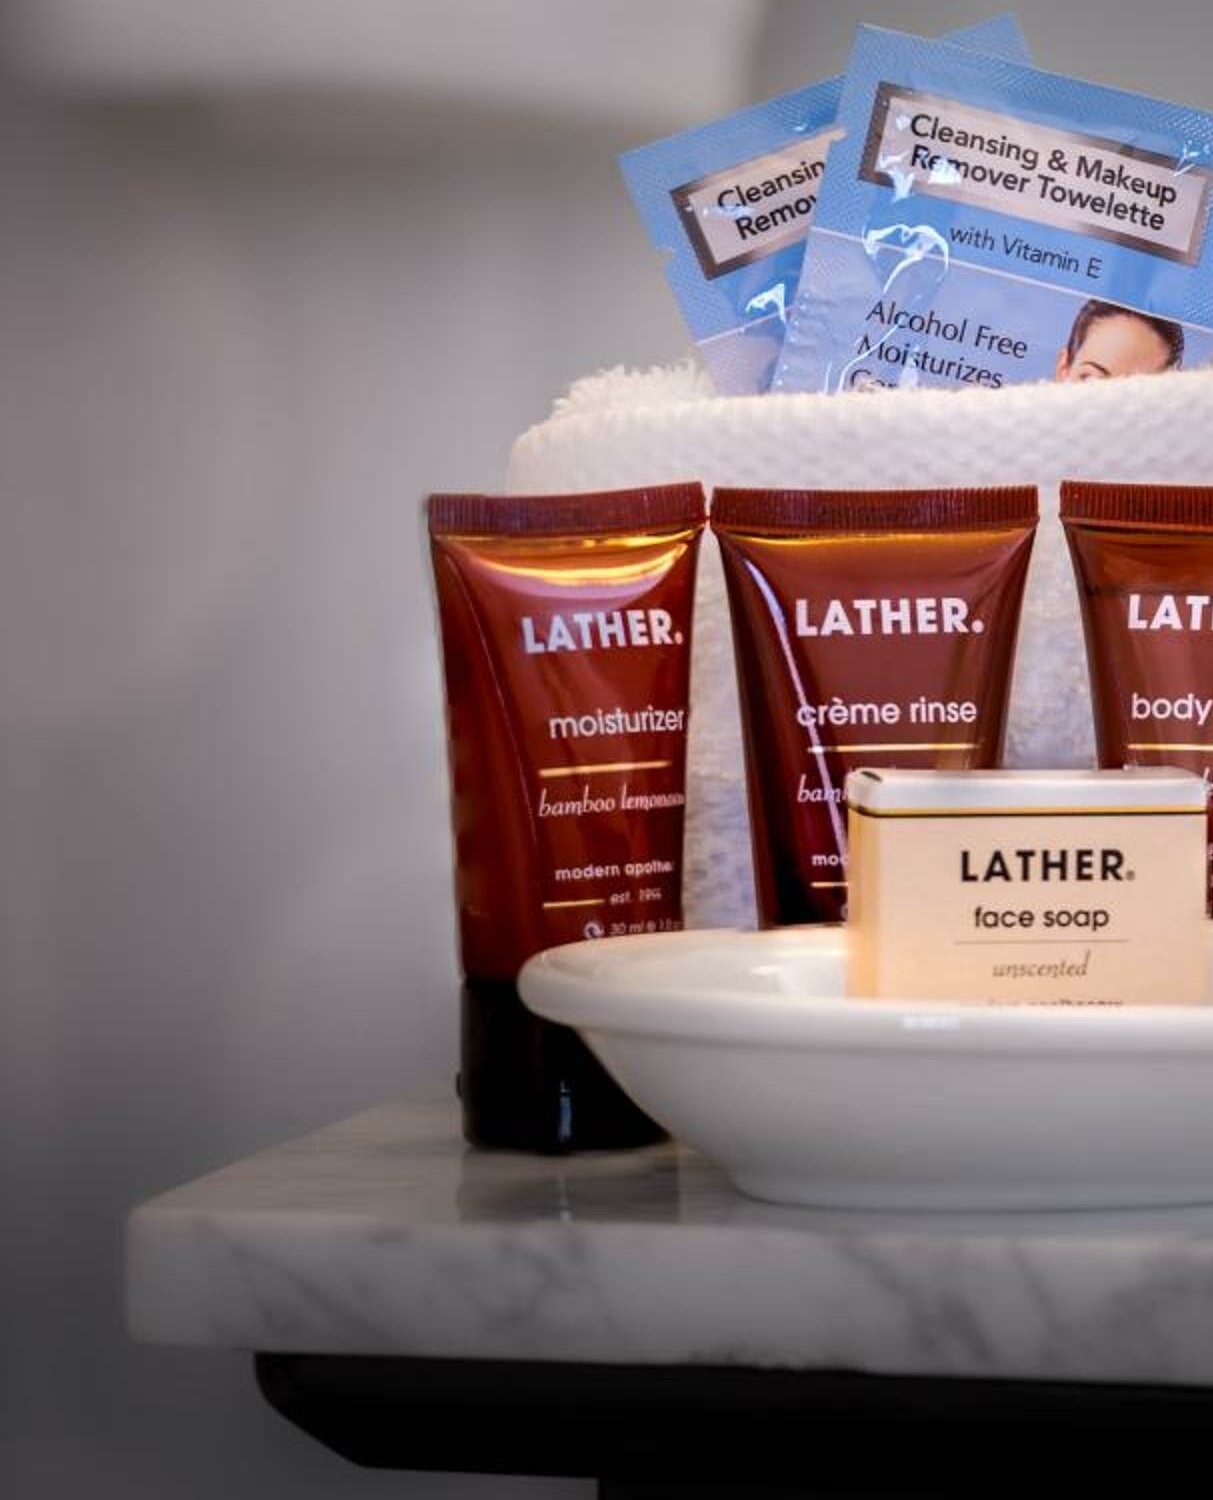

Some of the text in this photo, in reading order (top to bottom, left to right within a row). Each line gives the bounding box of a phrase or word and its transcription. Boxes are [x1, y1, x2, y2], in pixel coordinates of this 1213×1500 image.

[910, 113, 1178, 205] Cleansing & Makeup
[717, 161, 826, 207] Cleansin
[911, 144, 1166, 231] Remover Towelette
[735, 195, 817, 240] Remo
[950, 224, 1102, 279] with Vitamin E
[865, 299, 1028, 359] Alcohol Free
[857, 334, 1004, 389] Moisturizes
[549, 704, 686, 740] moisturizer
[797, 696, 978, 726] crème rinse
[1131, 692, 1213, 724] body
[538, 783, 616, 817] bamboo
[797, 773, 848, 803] bam
[555, 863, 621, 881] modern
[974, 906, 1110, 932] face soap
[992, 948, 1092, 979] unscented
